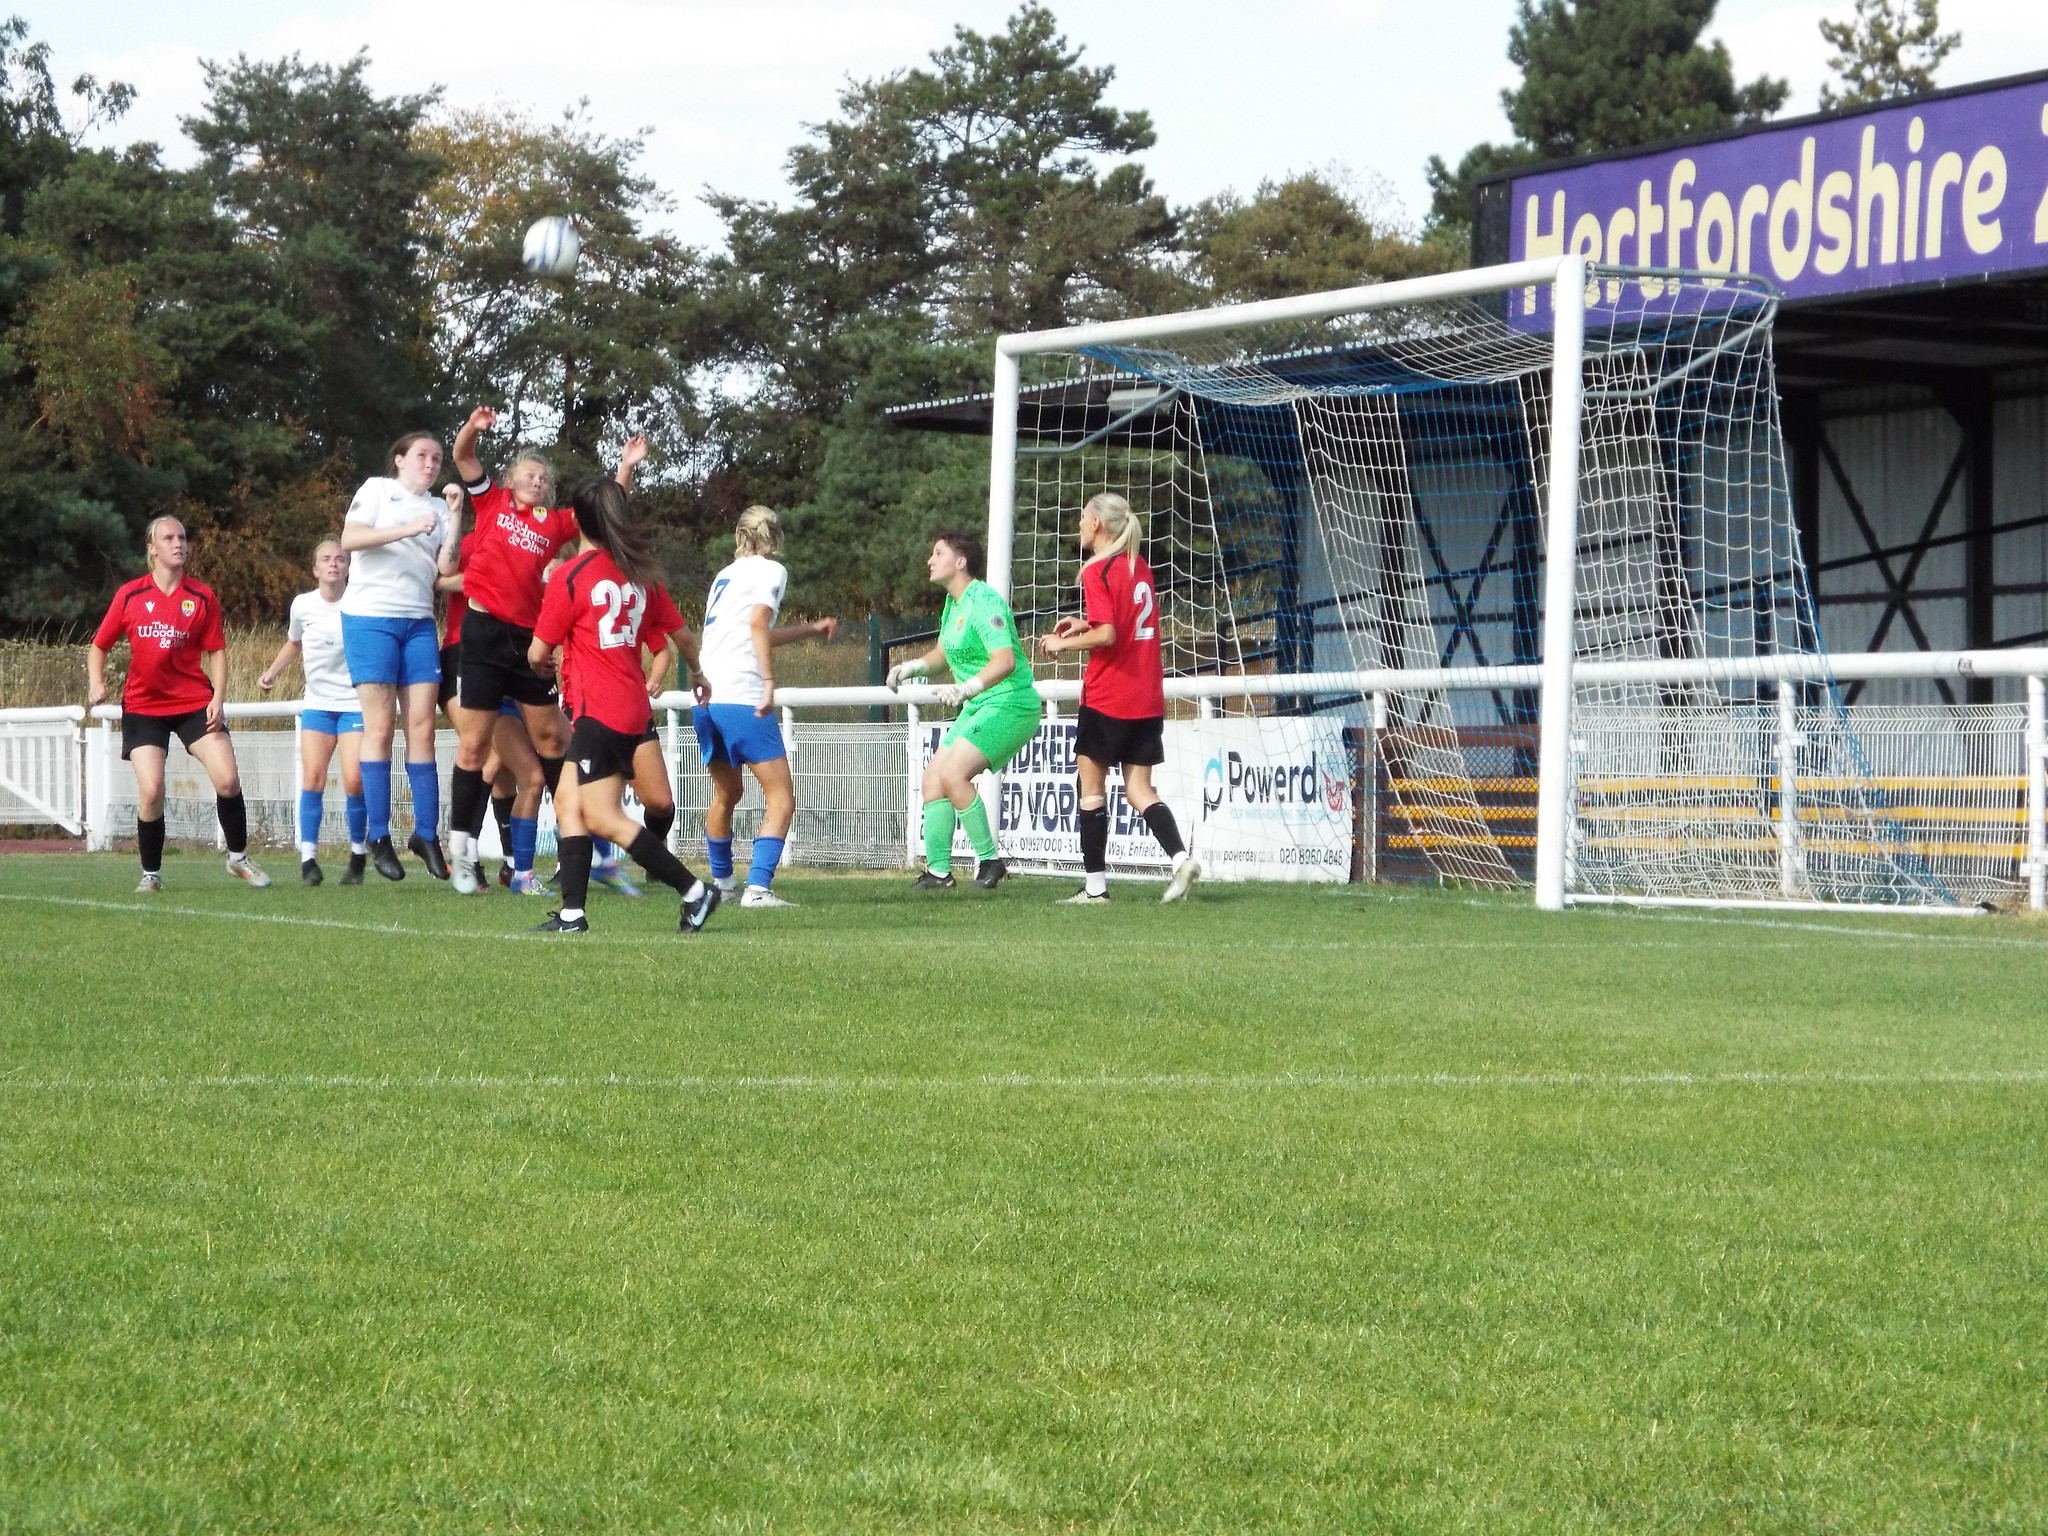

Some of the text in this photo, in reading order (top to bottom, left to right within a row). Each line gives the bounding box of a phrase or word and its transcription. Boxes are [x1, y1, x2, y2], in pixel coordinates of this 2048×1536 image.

[1523, 116, 2007, 316] Hertfordshire
[497, 513, 550, 546] Woodman
[591, 579, 646, 650] 23
[1134, 581, 1155, 640] 2
[1228, 750, 1322, 803] Powerd
[1280, 848, 1297, 864] 020
